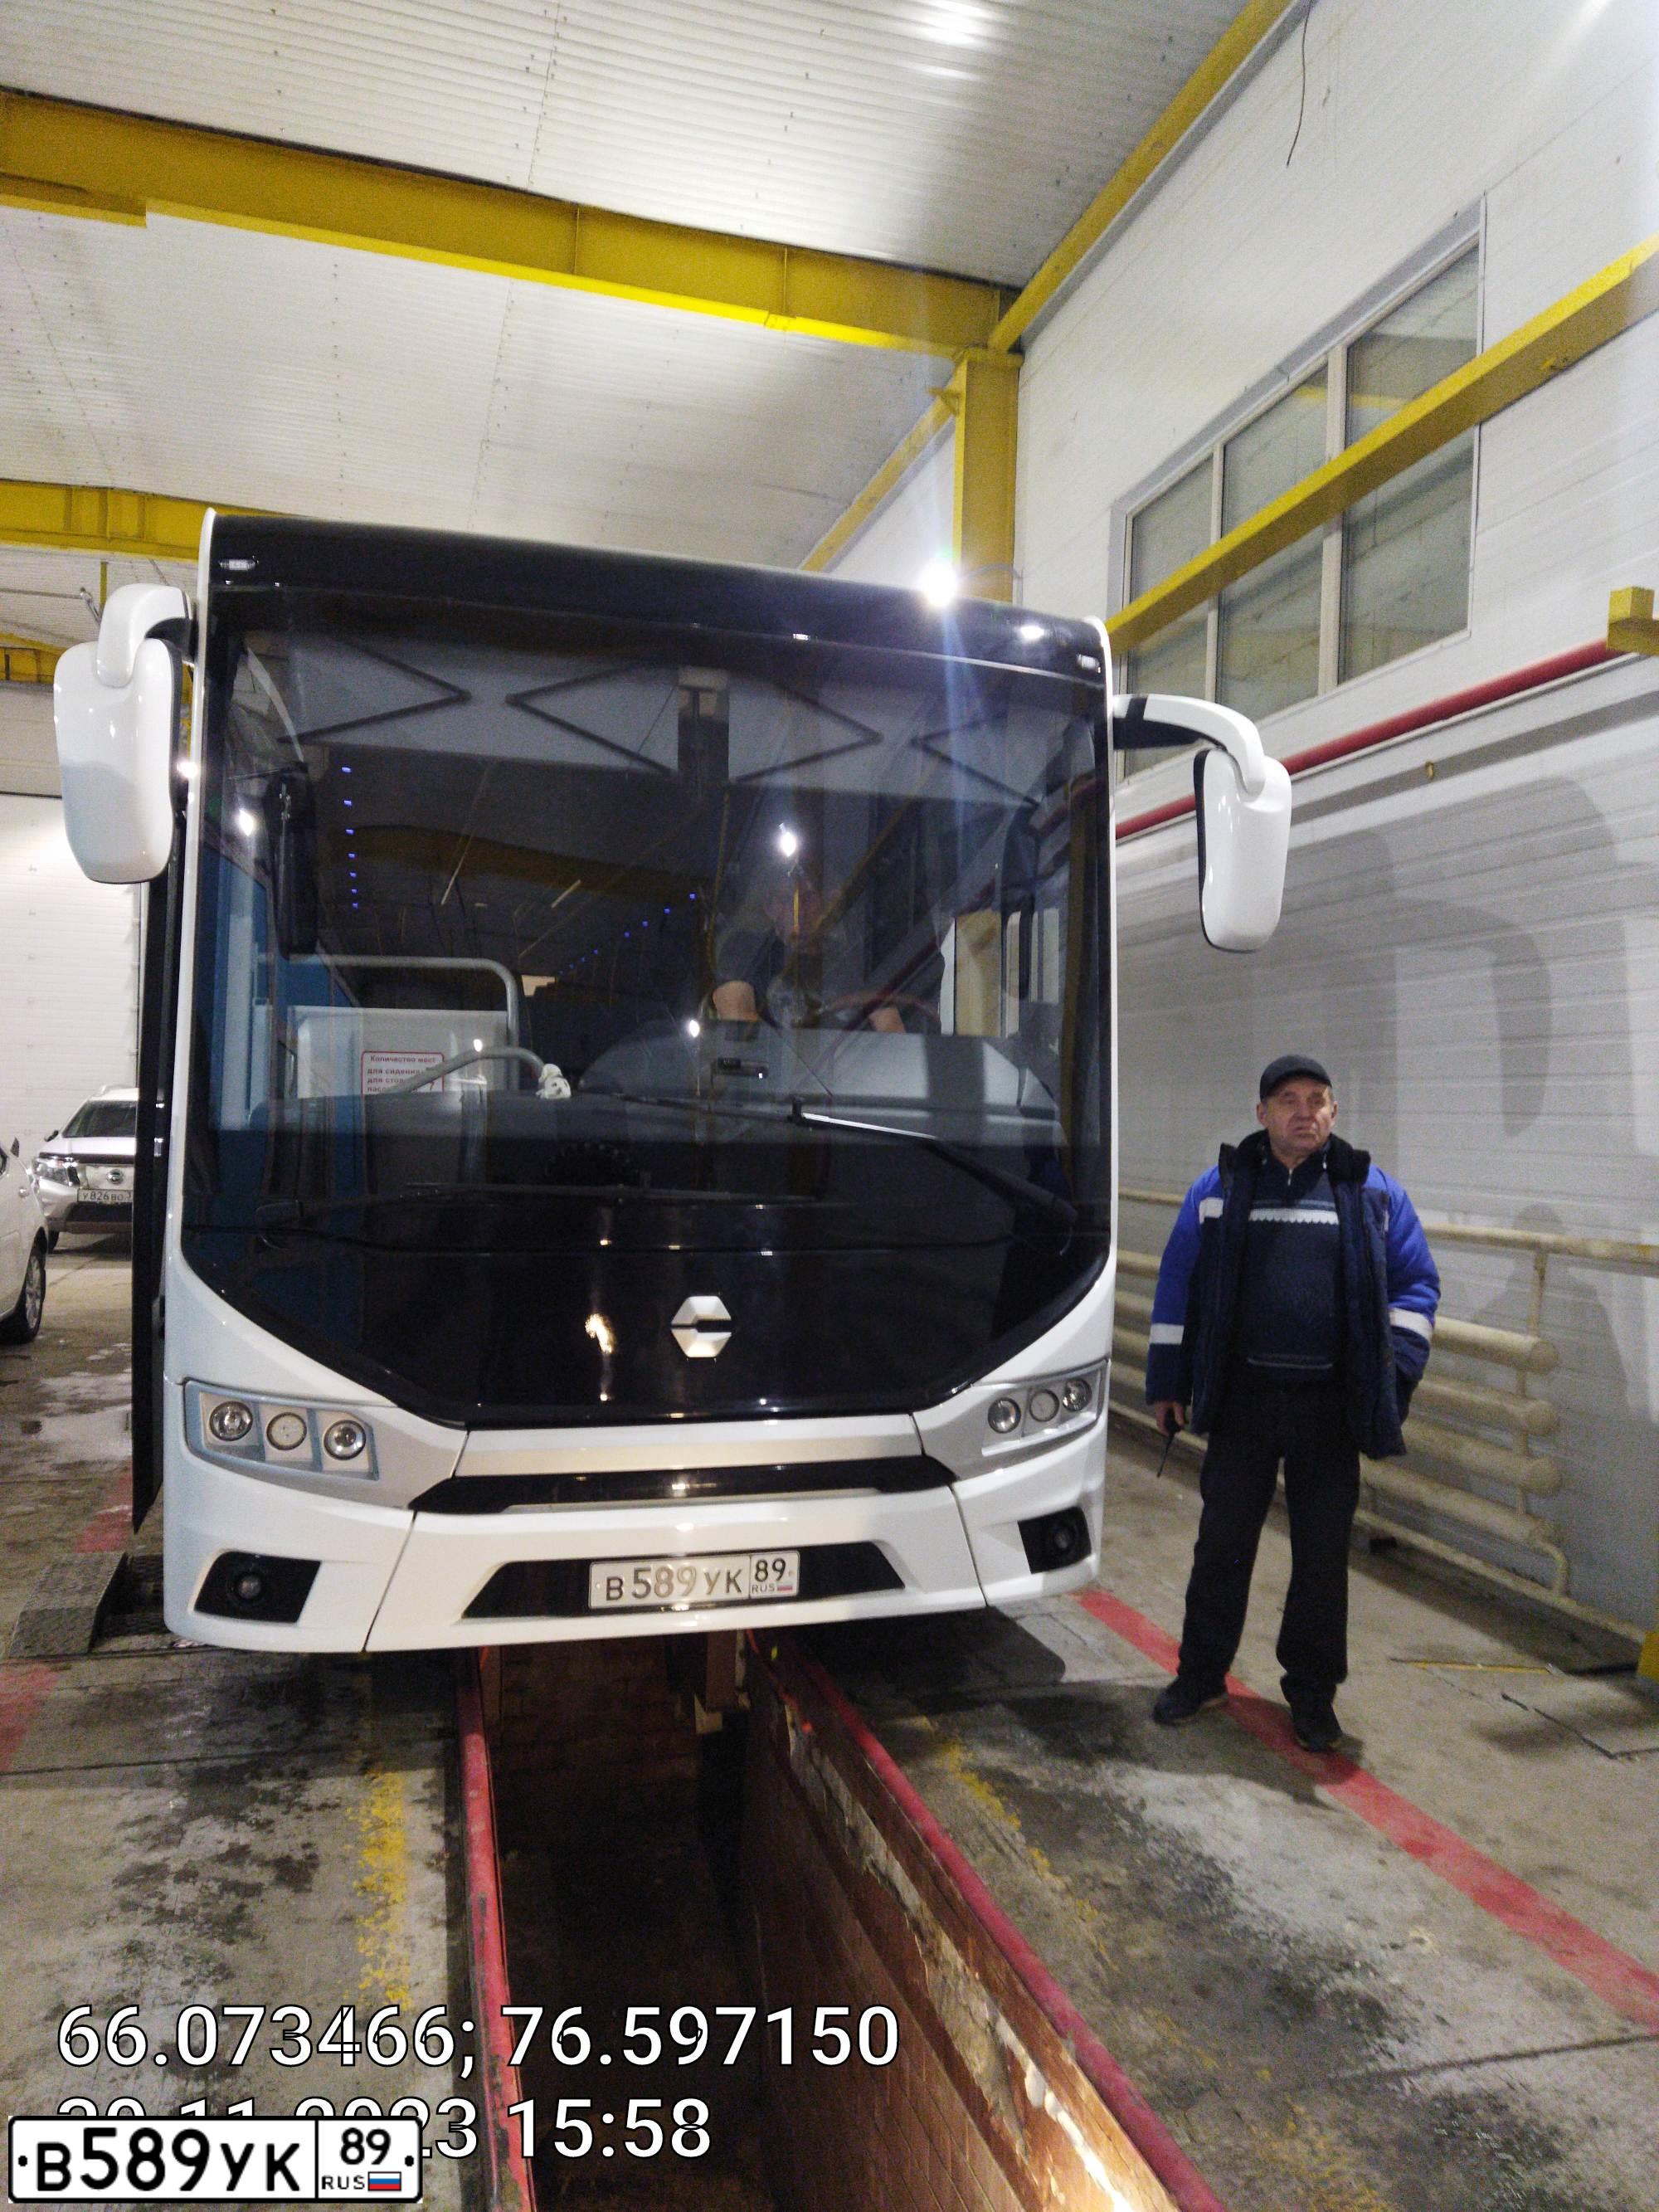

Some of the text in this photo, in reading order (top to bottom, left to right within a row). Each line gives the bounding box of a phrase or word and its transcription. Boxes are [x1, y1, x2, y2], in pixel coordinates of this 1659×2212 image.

[605, 1557, 786, 1601] В589УК 89
[751, 1582, 776, 1593] RUS
